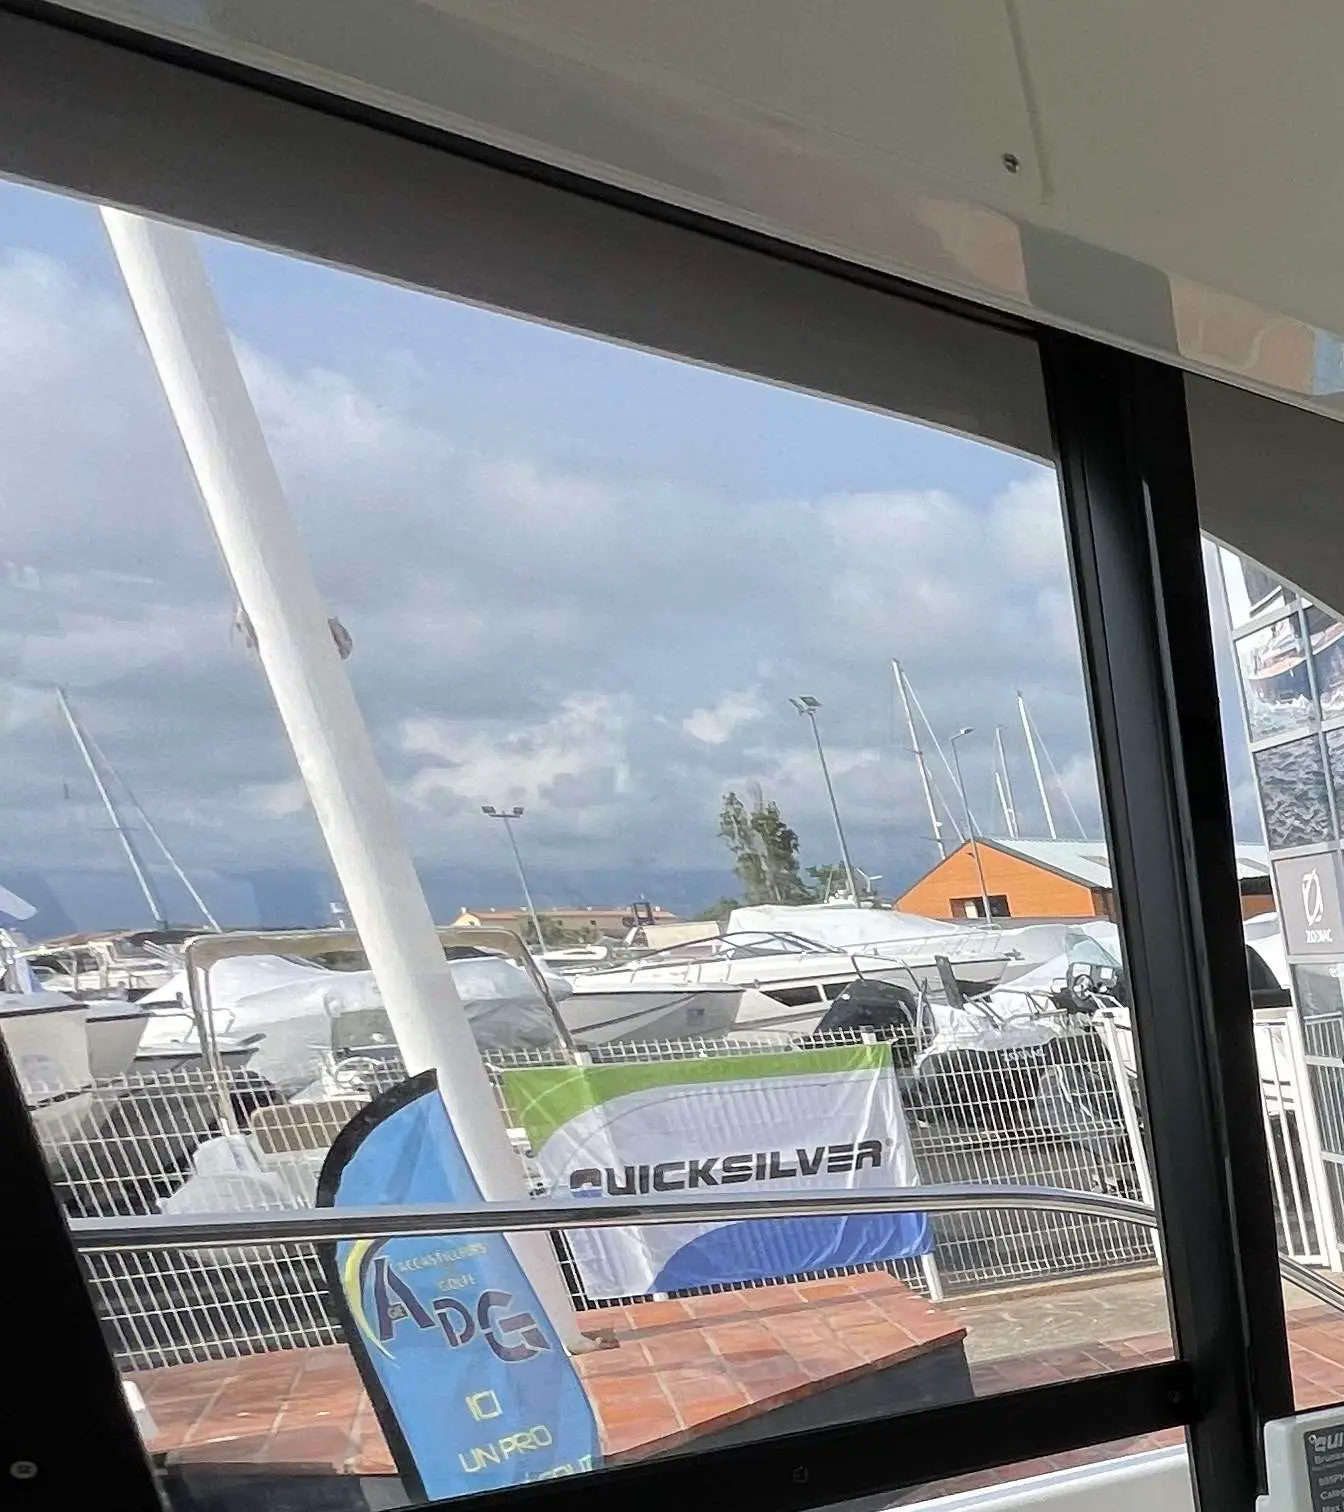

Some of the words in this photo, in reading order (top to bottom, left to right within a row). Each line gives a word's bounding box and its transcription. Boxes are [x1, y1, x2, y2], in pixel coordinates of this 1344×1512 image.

[569, 1139, 883, 1199] QUICKSILVER
[372, 1255, 553, 1364] ADG
[457, 1442, 500, 1474] UN
[498, 1424, 553, 1461] PRO
